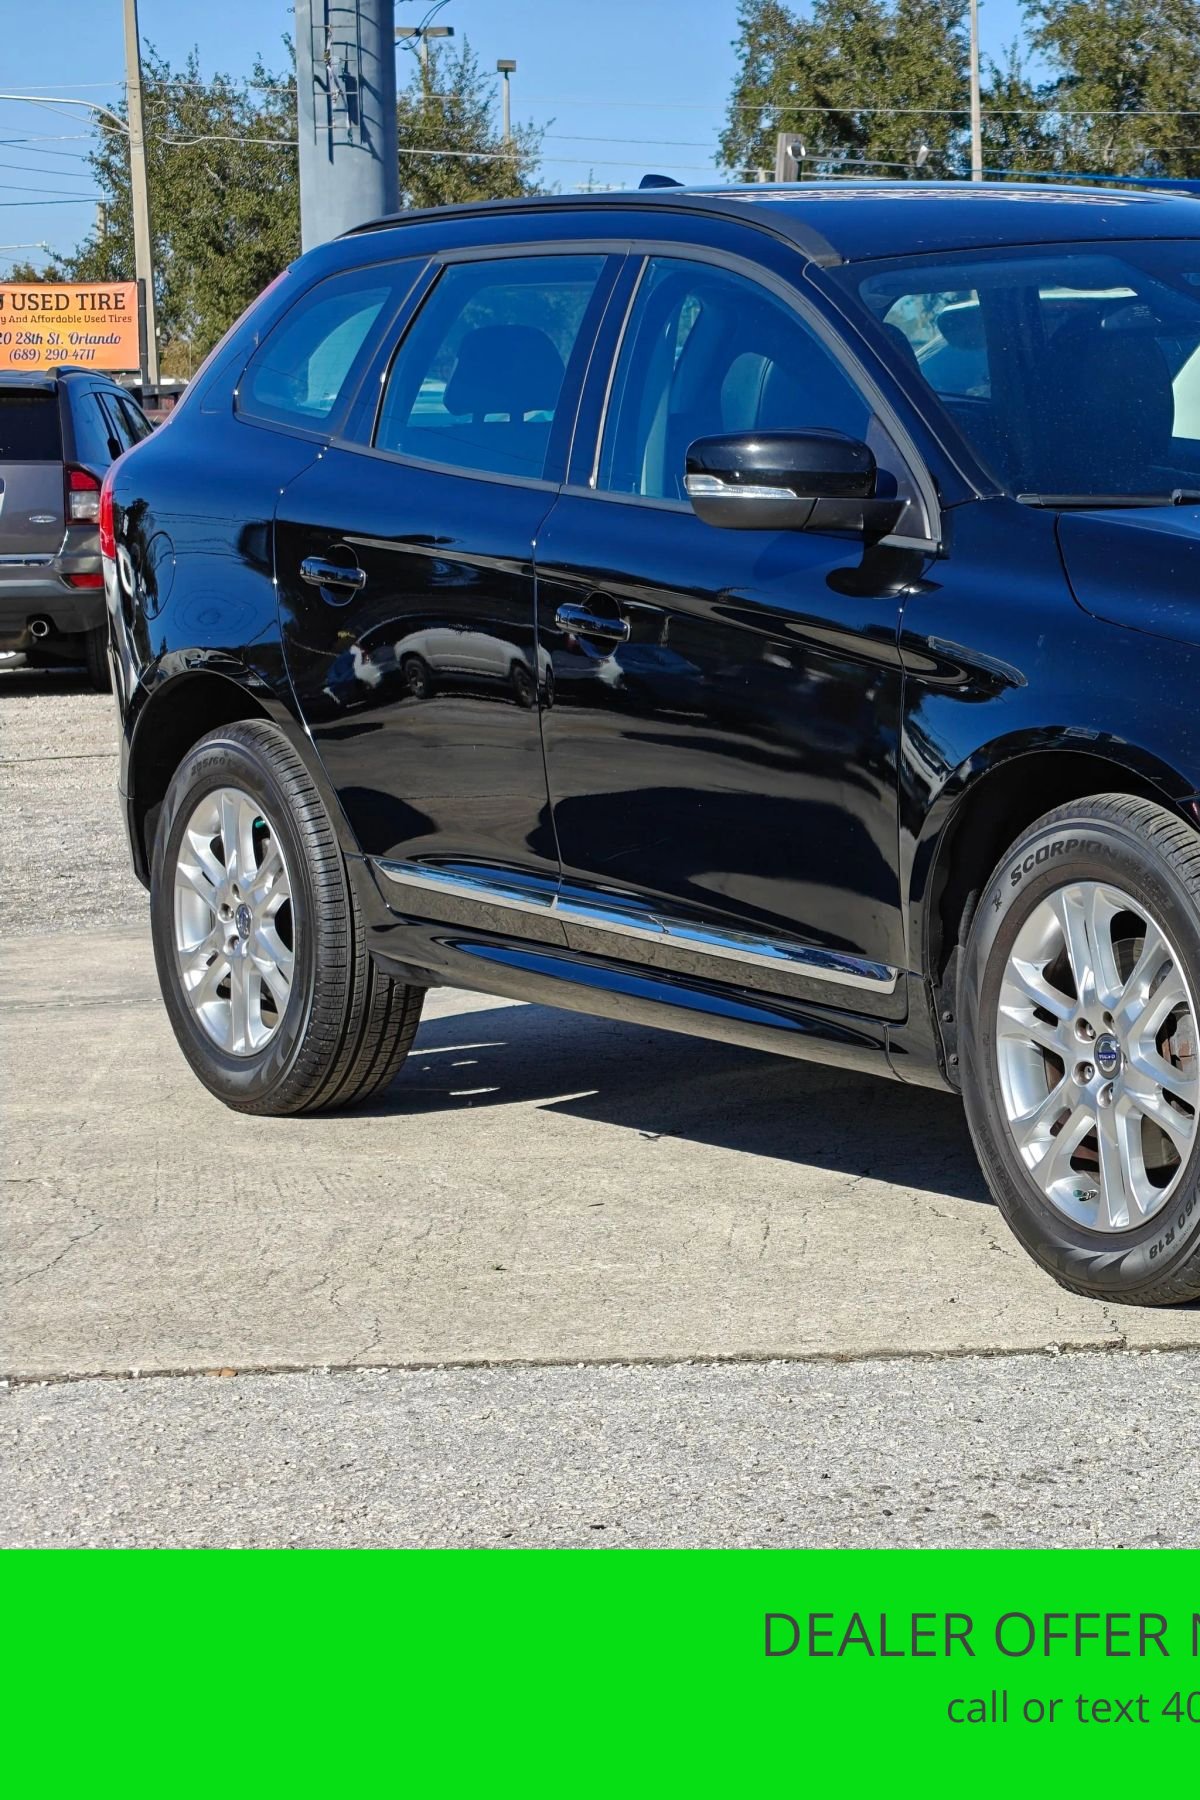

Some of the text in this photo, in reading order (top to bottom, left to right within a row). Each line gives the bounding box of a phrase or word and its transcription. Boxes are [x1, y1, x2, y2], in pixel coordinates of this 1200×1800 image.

[11, 293, 70, 311] USED
[75, 293, 126, 311] TIRE
[8, 315, 28, 323] And
[30, 314, 82, 323] Affordable
[84, 315, 107, 323] Used
[108, 314, 132, 323] Tires
[15, 331, 43, 345] 28th
[46, 332, 64, 345] St.
[68, 331, 122, 345] Orlando
[9, 348, 96, 363] (689) 290-4711
[1010, 838, 1117, 887] SCORPION
[1149, 1226, 1176, 1259] R18
